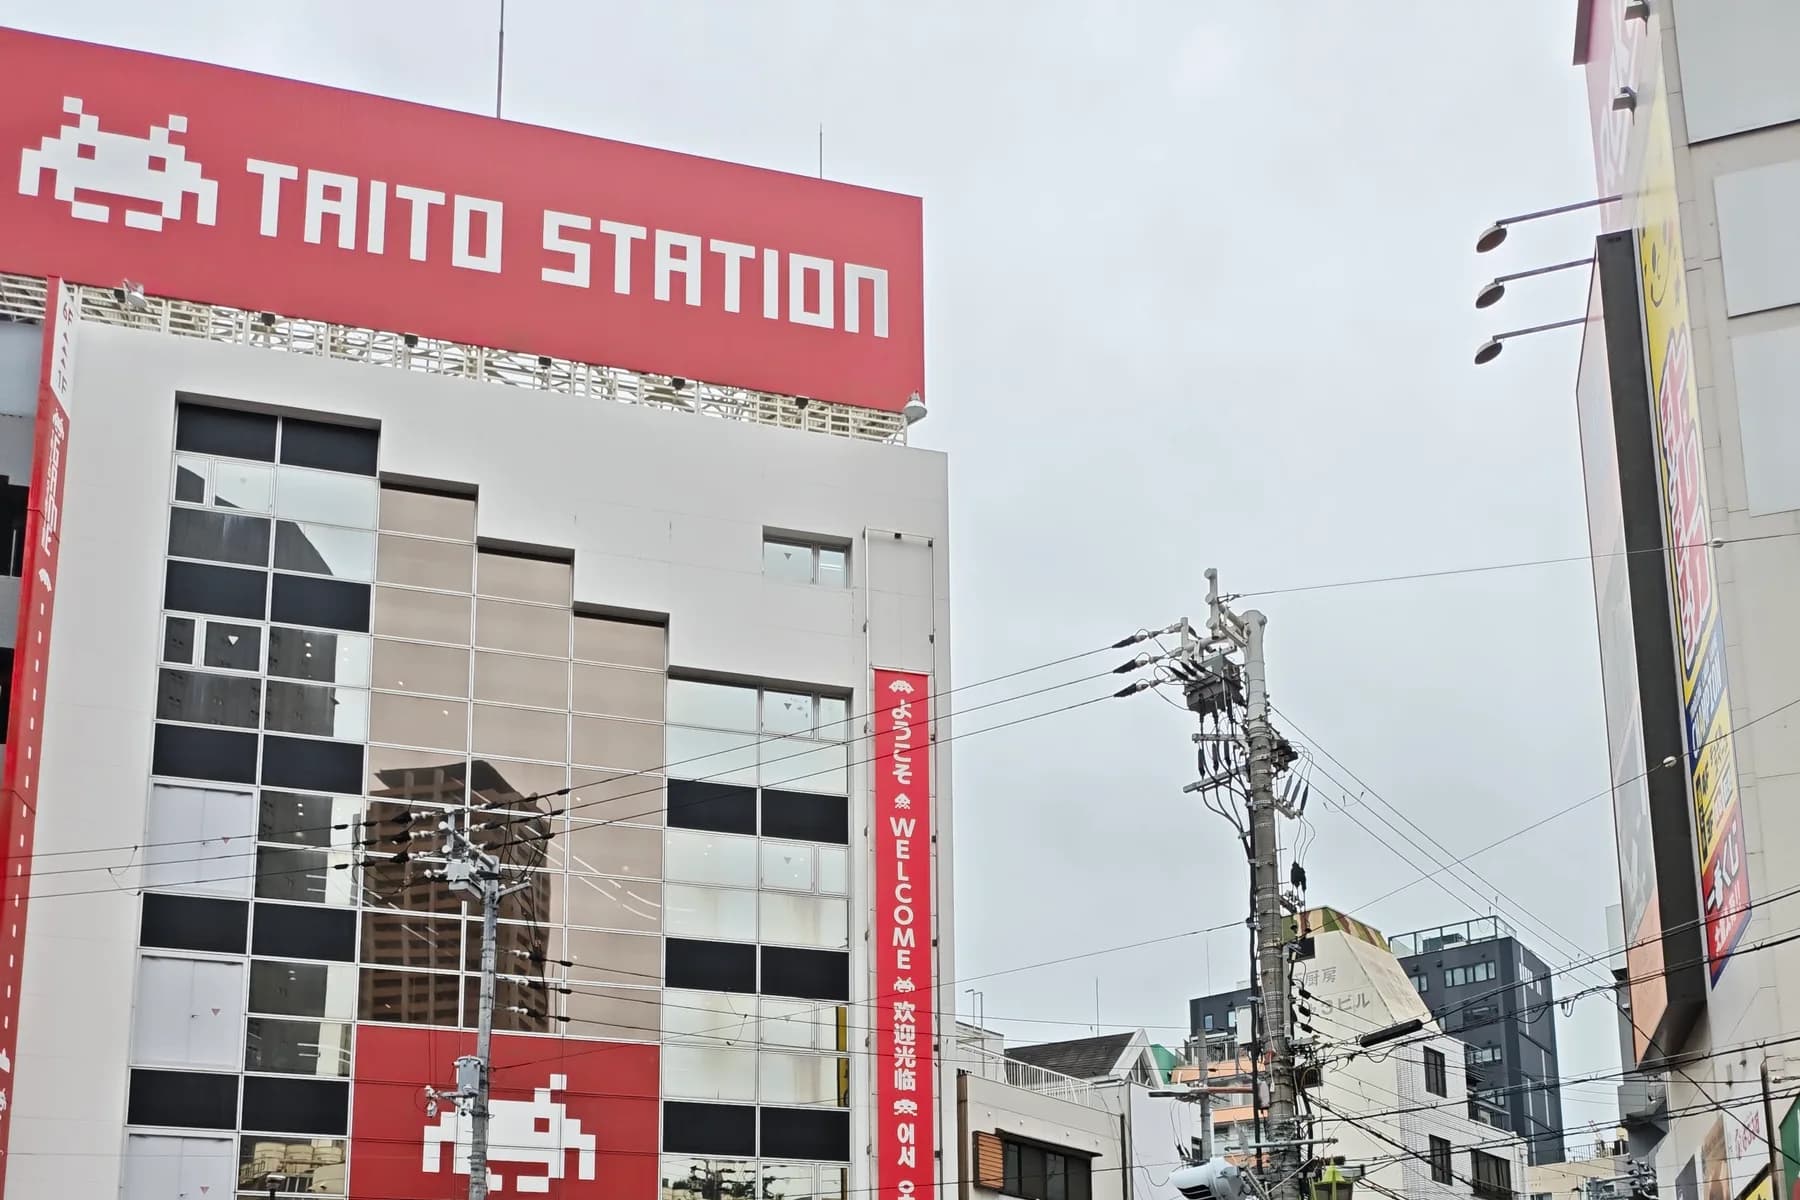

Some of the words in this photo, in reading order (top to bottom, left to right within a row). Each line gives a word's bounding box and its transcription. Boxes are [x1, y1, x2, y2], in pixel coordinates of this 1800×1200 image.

[246, 157, 503, 274] TAITO
[541, 211, 889, 339] STATION
[891, 699, 913, 785] ようこそ
[890, 816, 916, 970] WELCOME
[893, 1001, 917, 1092] 欢迎光临
[897, 1123, 915, 1169] 어서
